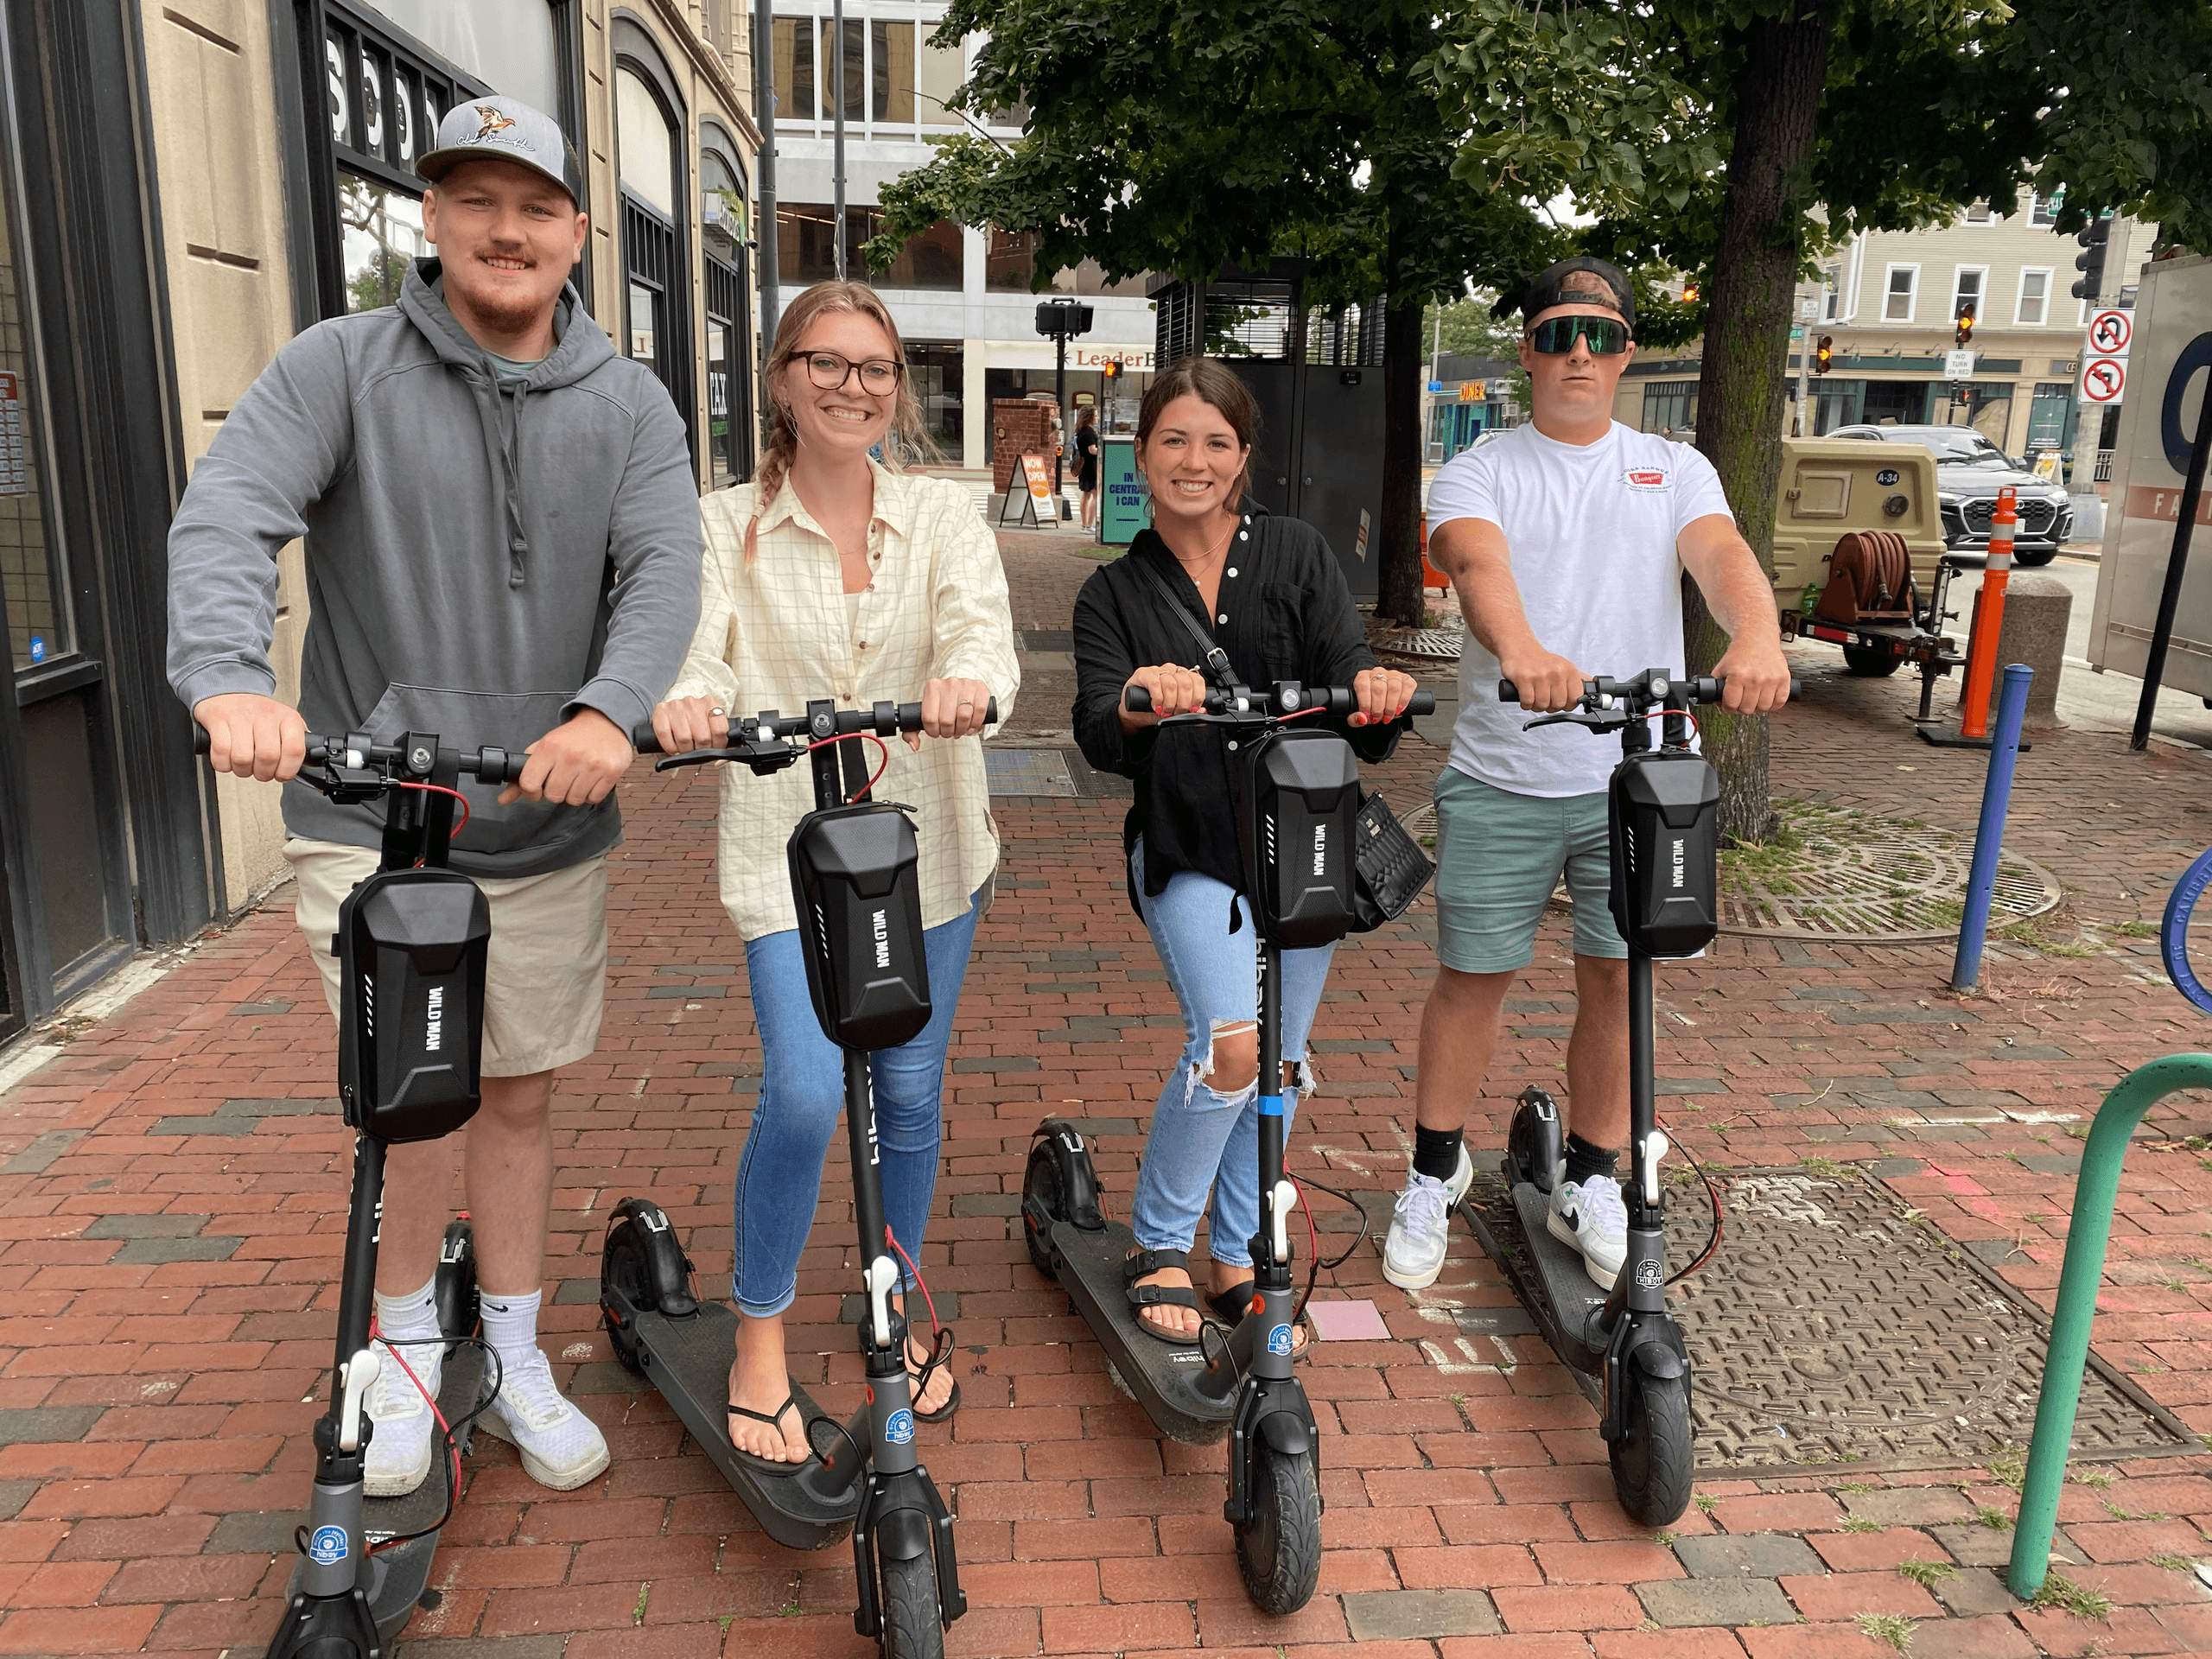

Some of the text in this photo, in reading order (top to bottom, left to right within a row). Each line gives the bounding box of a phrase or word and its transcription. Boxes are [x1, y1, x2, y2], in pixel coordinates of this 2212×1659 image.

[456, 132, 536, 151] Old South
[1459, 381, 1486, 401] DINER
[1025, 458, 1042, 468] NOW
[1027, 471, 1046, 482] OPEN
[1123, 472, 1134, 482] IN
[1877, 473, 1898, 483] A-34
[1116, 496, 1140, 505] I CAN
